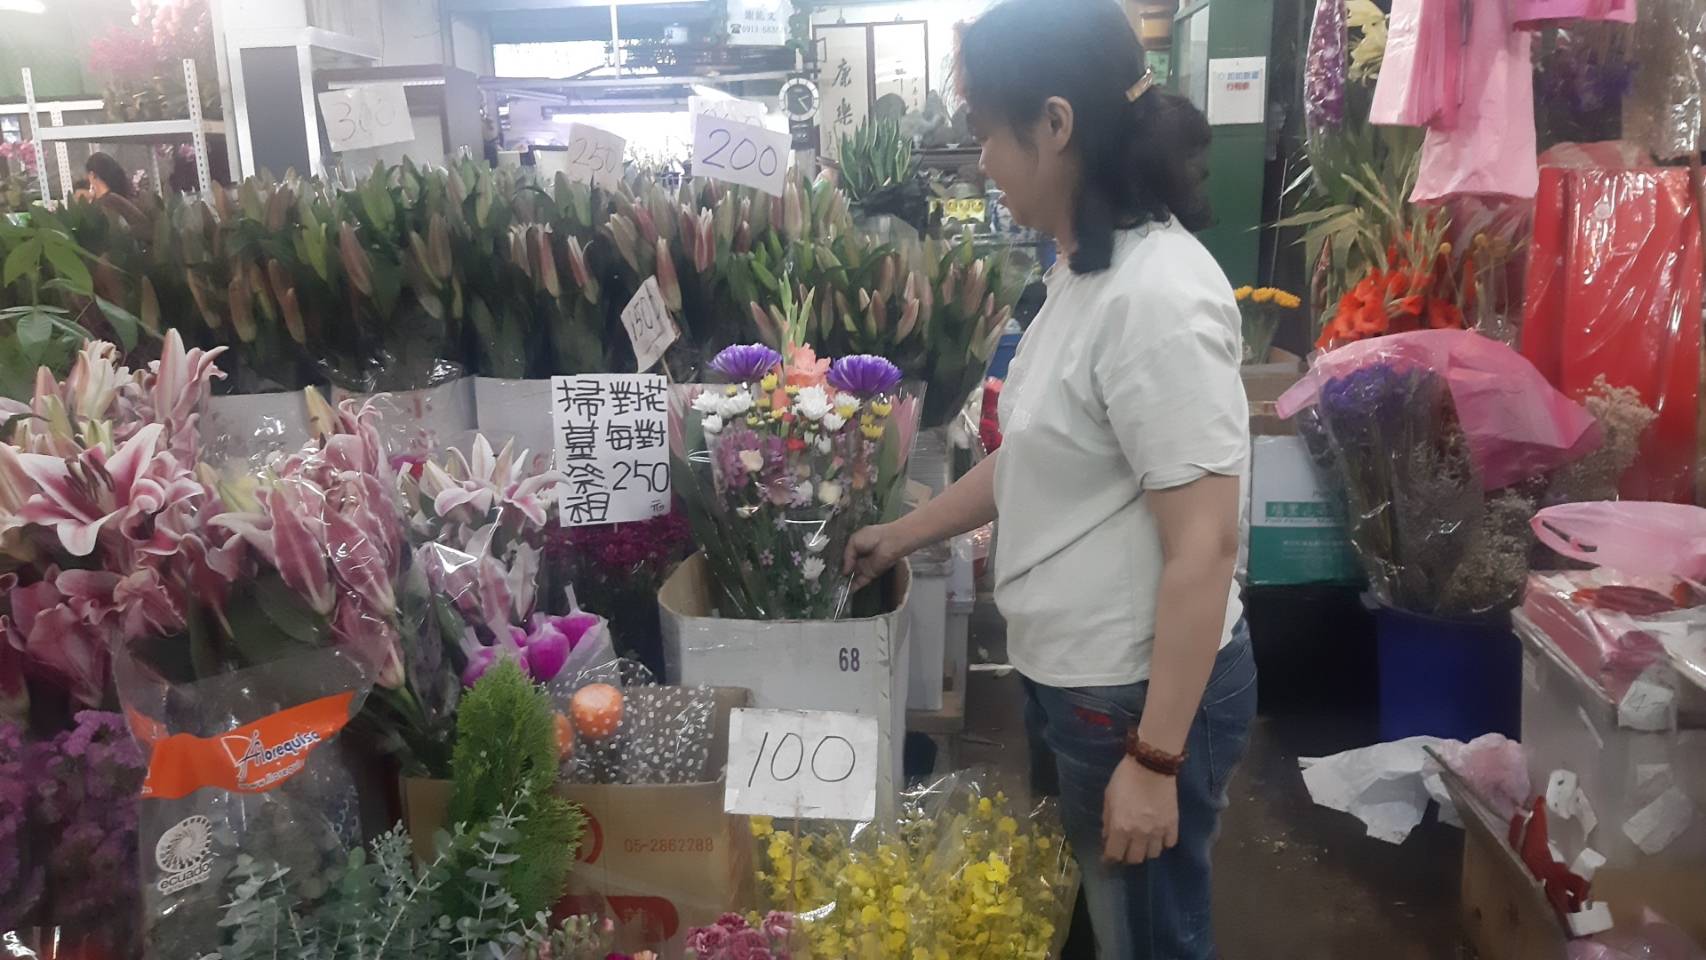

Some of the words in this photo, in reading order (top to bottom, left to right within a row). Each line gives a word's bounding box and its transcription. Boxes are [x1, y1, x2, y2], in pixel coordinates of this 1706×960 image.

[571, 136, 616, 174] 250
[701, 128, 778, 177] 200
[612, 460, 669, 493] 250
[838, 646, 861, 673] 68
[747, 731, 857, 788] 100
[160, 862, 209, 889] ecuado
